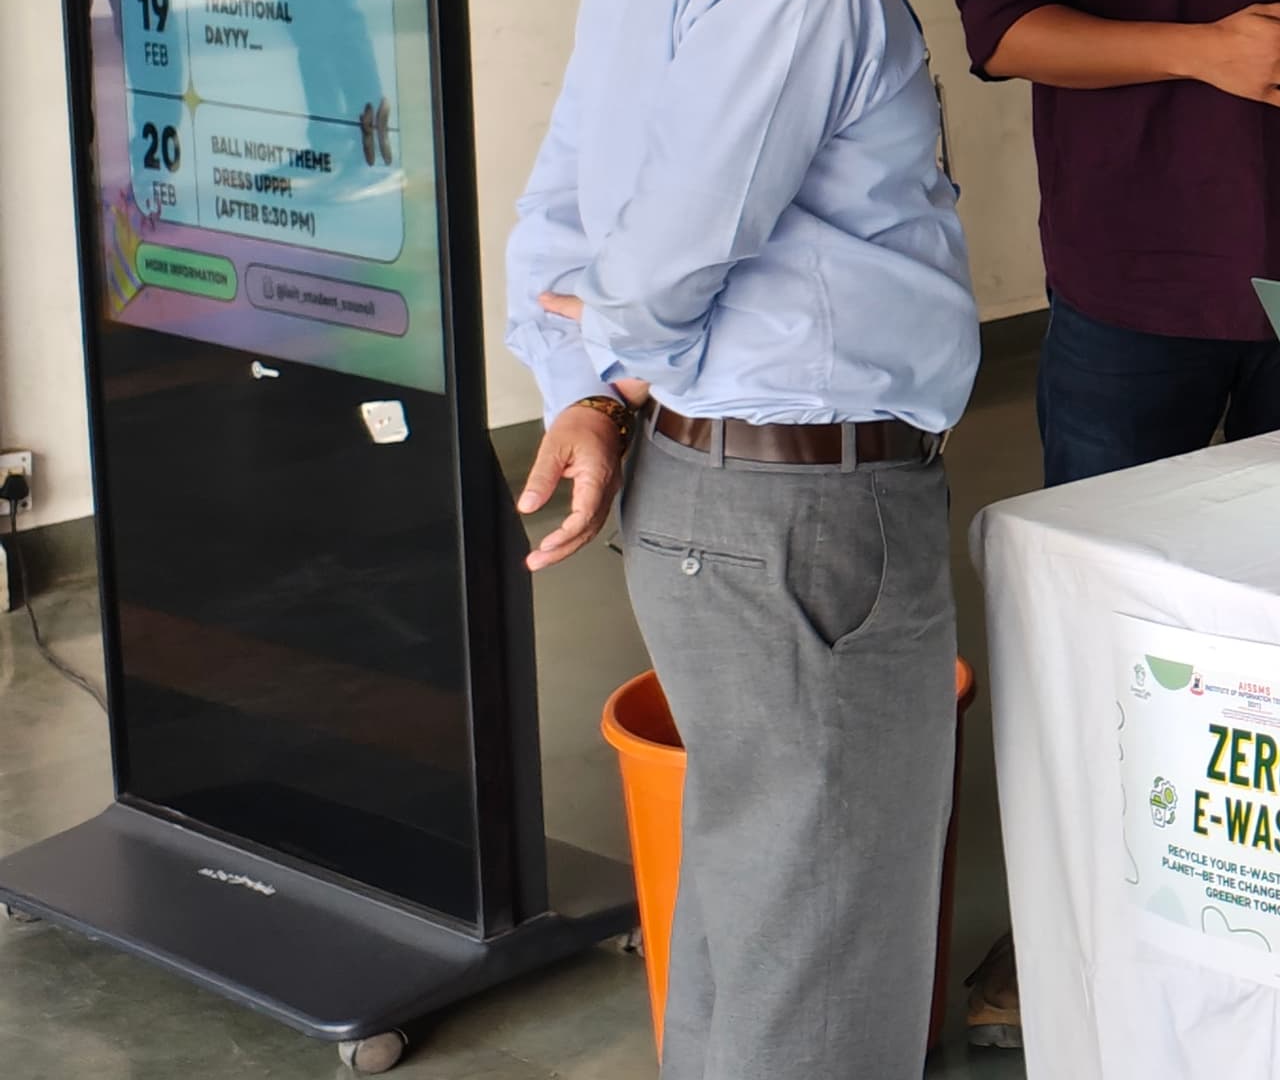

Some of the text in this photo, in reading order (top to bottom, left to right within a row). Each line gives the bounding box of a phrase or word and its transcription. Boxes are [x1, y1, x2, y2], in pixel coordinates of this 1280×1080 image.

[145, 42, 168, 68] FEB
[143, 124, 181, 172] 20
[212, 135, 332, 173] BALL NIGHT THEME
[213, 166, 252, 191] DRESS
[152, 181, 177, 206] FEB
[215, 196, 316, 236] (AFTER PM)
[145, 258, 227, 286] MORE INFORMATION
[1168, 844, 1208, 867] RECYCLE
[1209, 856, 1237, 875] YOUR
[1217, 874, 1236, 889] THE
[1206, 887, 1252, 908] GREENER
